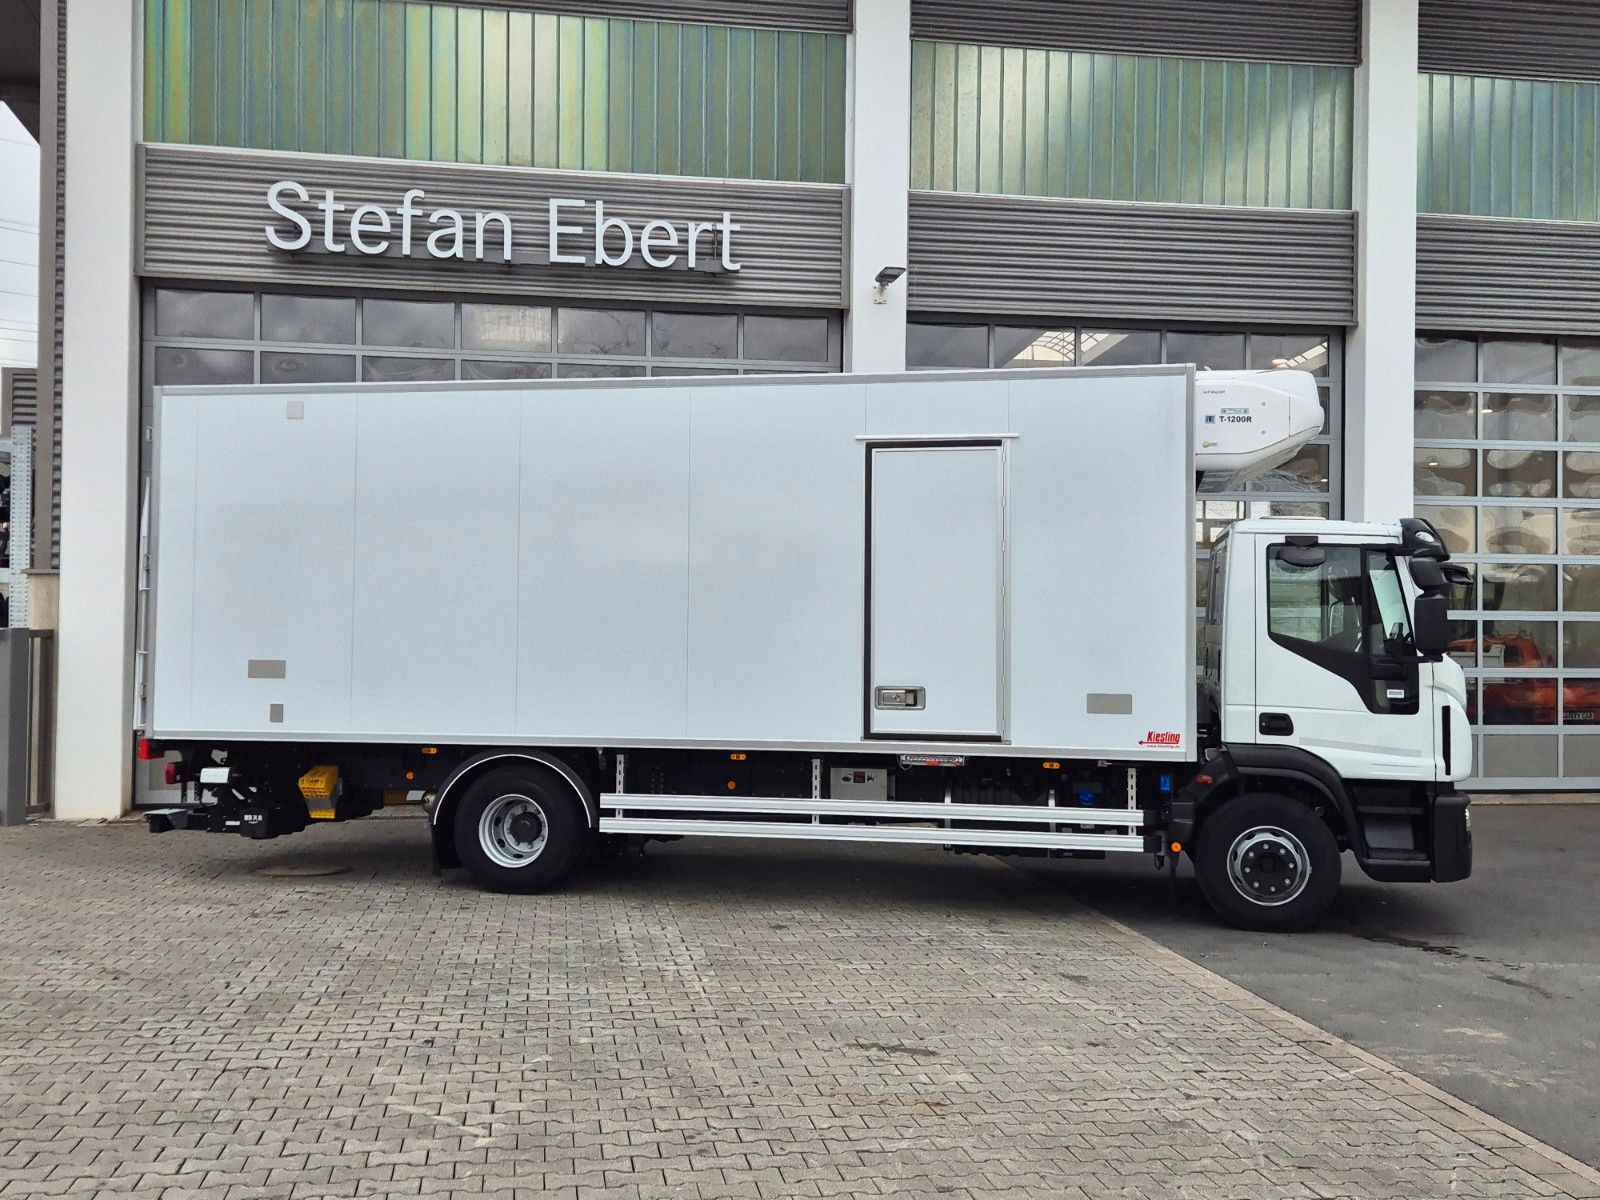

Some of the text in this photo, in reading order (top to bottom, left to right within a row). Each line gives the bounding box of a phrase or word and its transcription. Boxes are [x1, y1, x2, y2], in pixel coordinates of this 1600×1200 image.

[264, 181, 741, 271] Stefan Ebert
[1219, 415, 1252, 423] T-1200R
[1147, 731, 1181, 744] Kiesling
